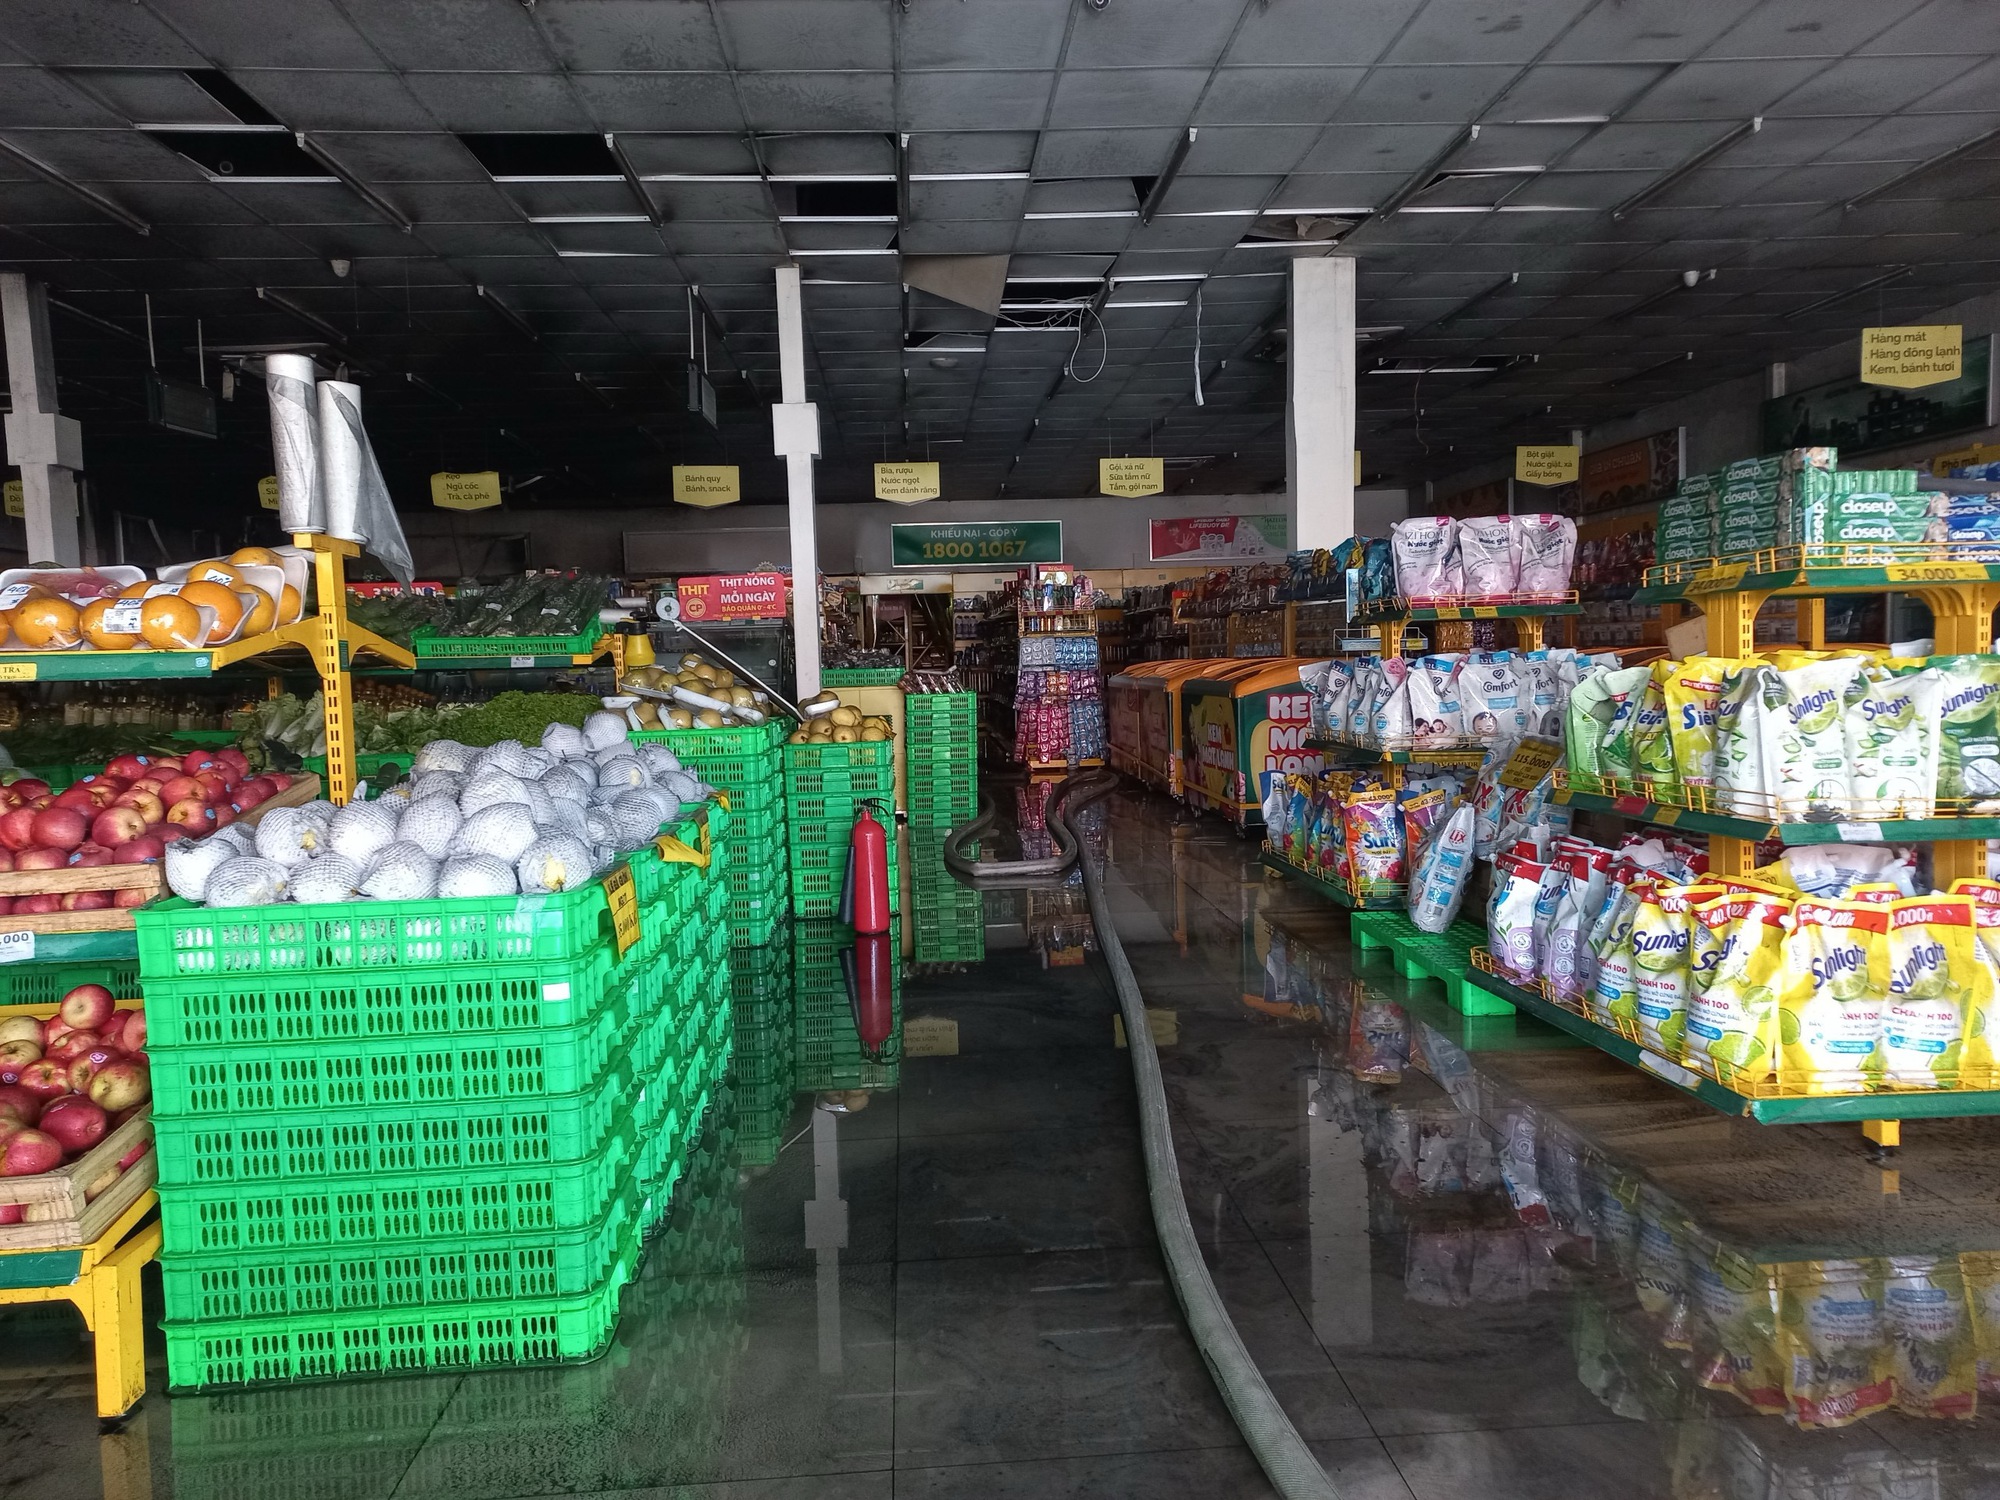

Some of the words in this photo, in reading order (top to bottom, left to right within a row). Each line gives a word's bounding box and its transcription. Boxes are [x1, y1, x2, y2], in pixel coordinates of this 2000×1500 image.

[1904, 332, 1927, 342] mát
[1936, 346, 1960, 358] lạnh
[1901, 362, 1930, 373] bánh
[1933, 361, 1955, 372] tươi
[1727, 466, 1761, 481] closeup
[1681, 481, 1710, 495] closeup
[1723, 489, 1758, 505] closeup
[1664, 504, 1692, 517] closeup
[1840, 500, 1897, 516] closeup
[1725, 513, 1758, 528] closeup
[930, 527, 961, 539] KHIẾU
[963, 529, 981, 540] NẠI
[988, 528, 1010, 537] GÓP
[1665, 525, 1694, 539] closeup
[1839, 526, 1895, 541] closeup
[922, 542, 974, 559] 1800
[978, 540, 1027, 557] 1067
[1723, 537, 1757, 551] closeup
[1664, 547, 1694, 560] closeup
[1897, 568, 1957, 580] 34.000
[719, 578, 743, 590] THỊT
[745, 576, 775, 586] NÓNG
[679, 584, 710, 598] THỊT
[746, 592, 776, 603] NGÀY
[688, 603, 703, 613] CP
[1483, 678, 1519, 694] Comfort
[1269, 695, 1309, 720] KE
[1862, 695, 1912, 721] Sunght
[0, 932, 29, 945] 000
[1613, 965, 1628, 974] 100
[1811, 944, 1867, 990] Sunlight
[1889, 941, 1948, 994] Sunlight
[1659, 983, 1675, 991] 100
[1711, 999, 1729, 1010] 100
[1863, 1012, 1879, 1020] 100
[1891, 1006, 1935, 1021] CHAH
[1937, 1013, 1953, 1021] 100
